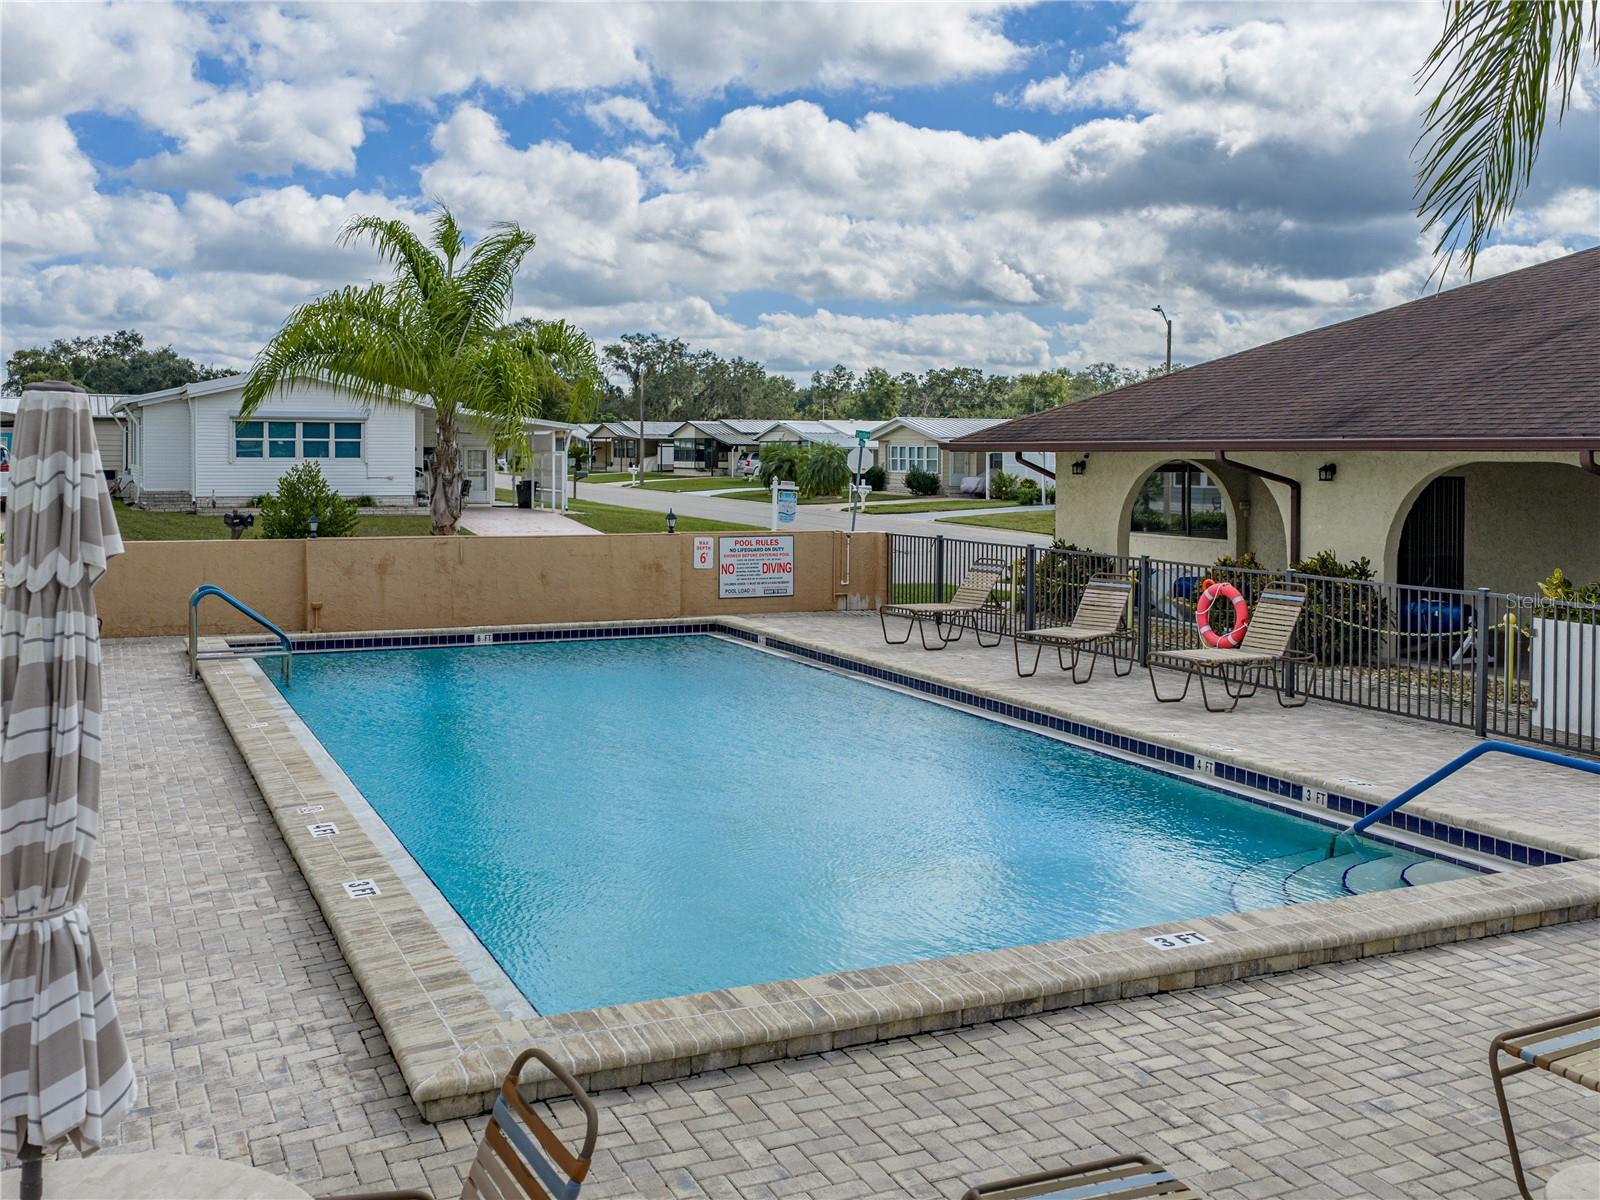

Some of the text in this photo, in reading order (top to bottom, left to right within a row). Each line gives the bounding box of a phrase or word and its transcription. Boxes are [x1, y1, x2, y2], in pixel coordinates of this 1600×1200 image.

[755, 538, 780, 546] RULES
[721, 563, 735, 575] NO
[762, 562, 792, 574] DIVING
[1197, 759, 1214, 773] 4 FT
[1306, 789, 1326, 805] 3 FT
[351, 887, 377, 897] FT
[1154, 932, 1206, 947] 3 FT
